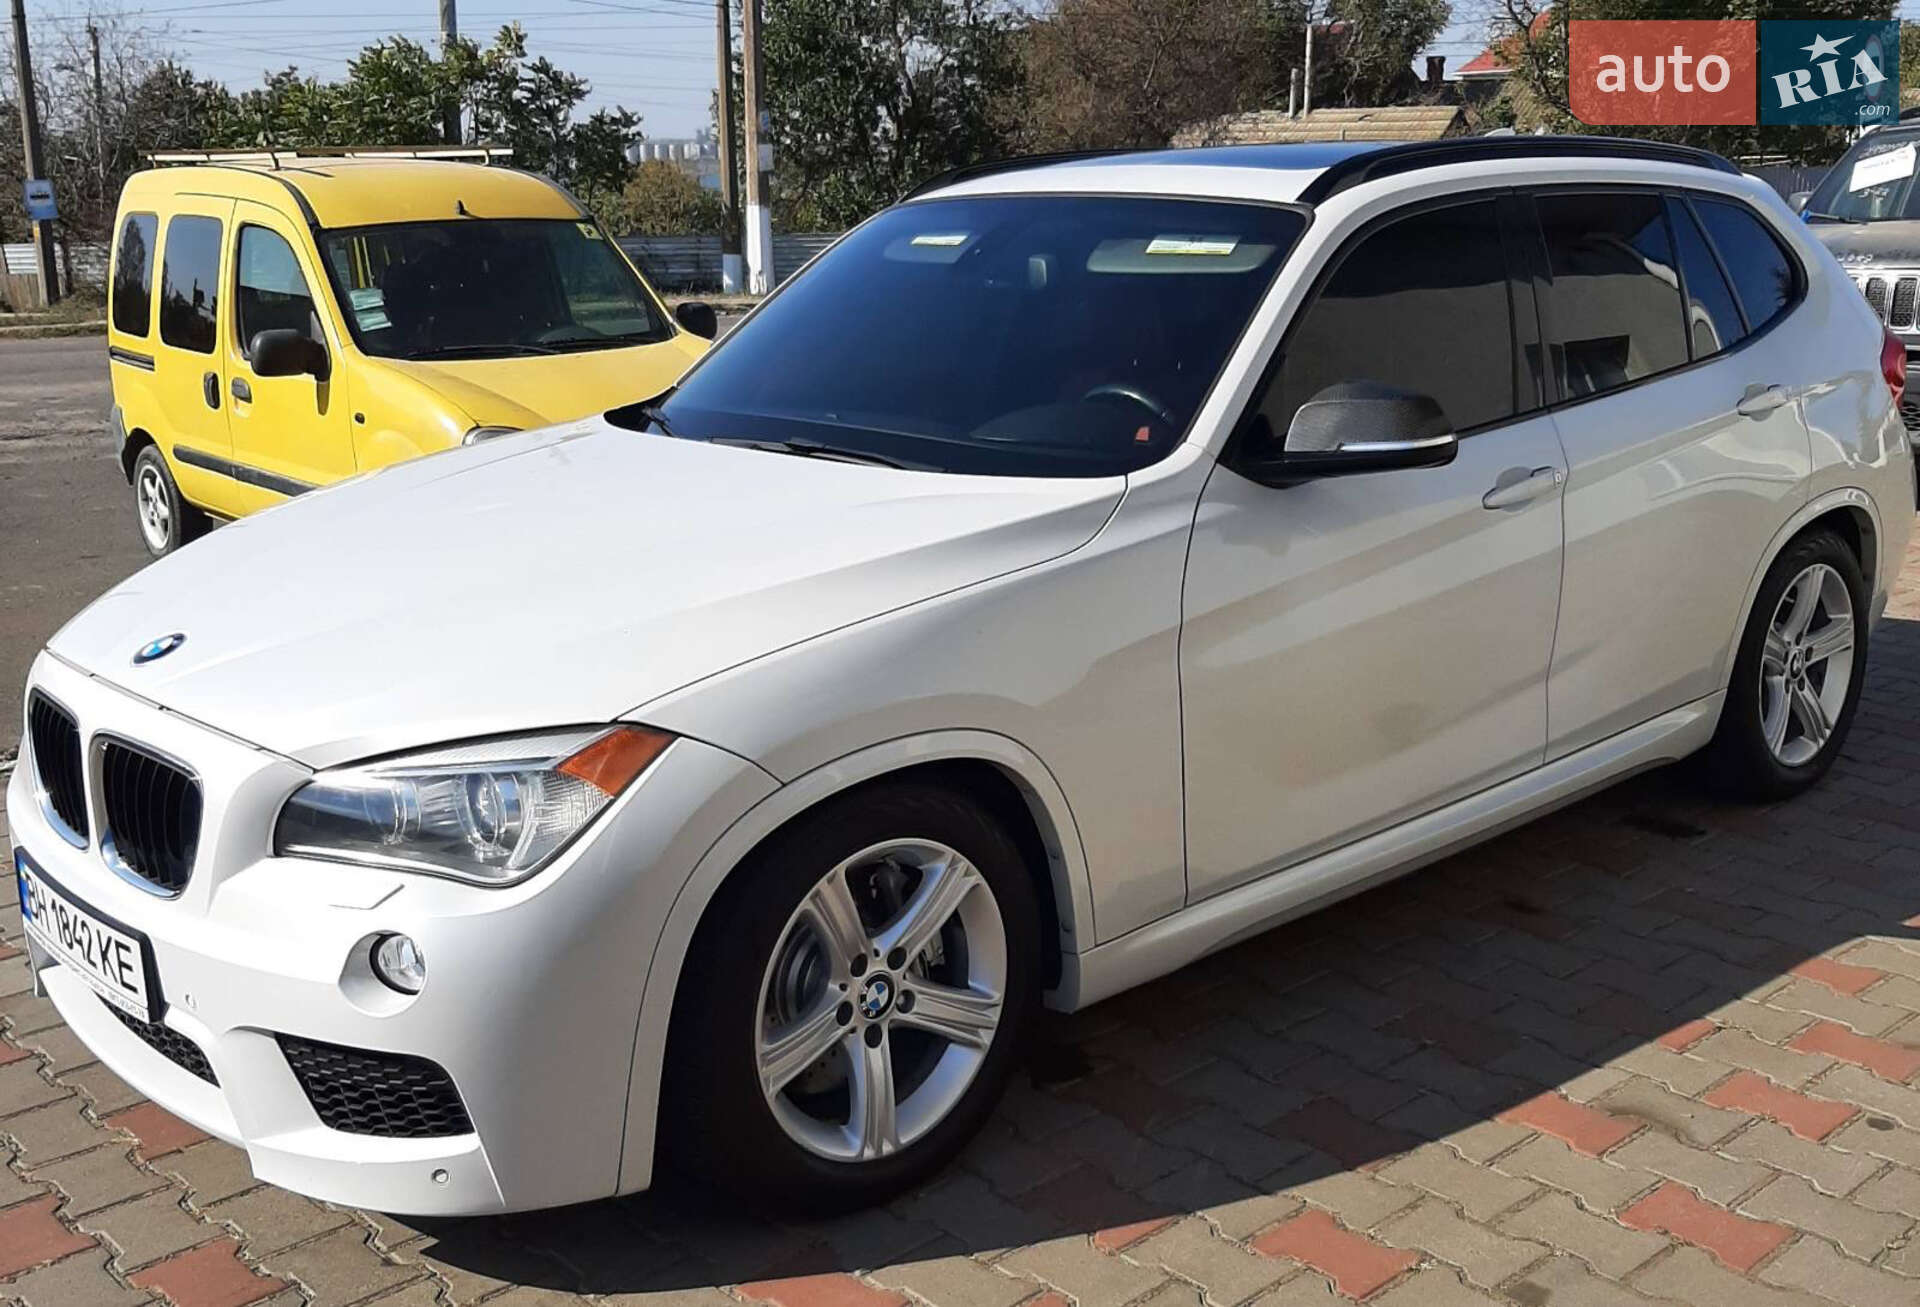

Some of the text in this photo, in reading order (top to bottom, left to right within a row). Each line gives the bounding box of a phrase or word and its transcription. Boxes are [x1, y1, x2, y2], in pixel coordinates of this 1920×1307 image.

[25, 872, 51, 934] BH
[51, 898, 97, 970] 1842
[96, 929, 139, 994] KE
